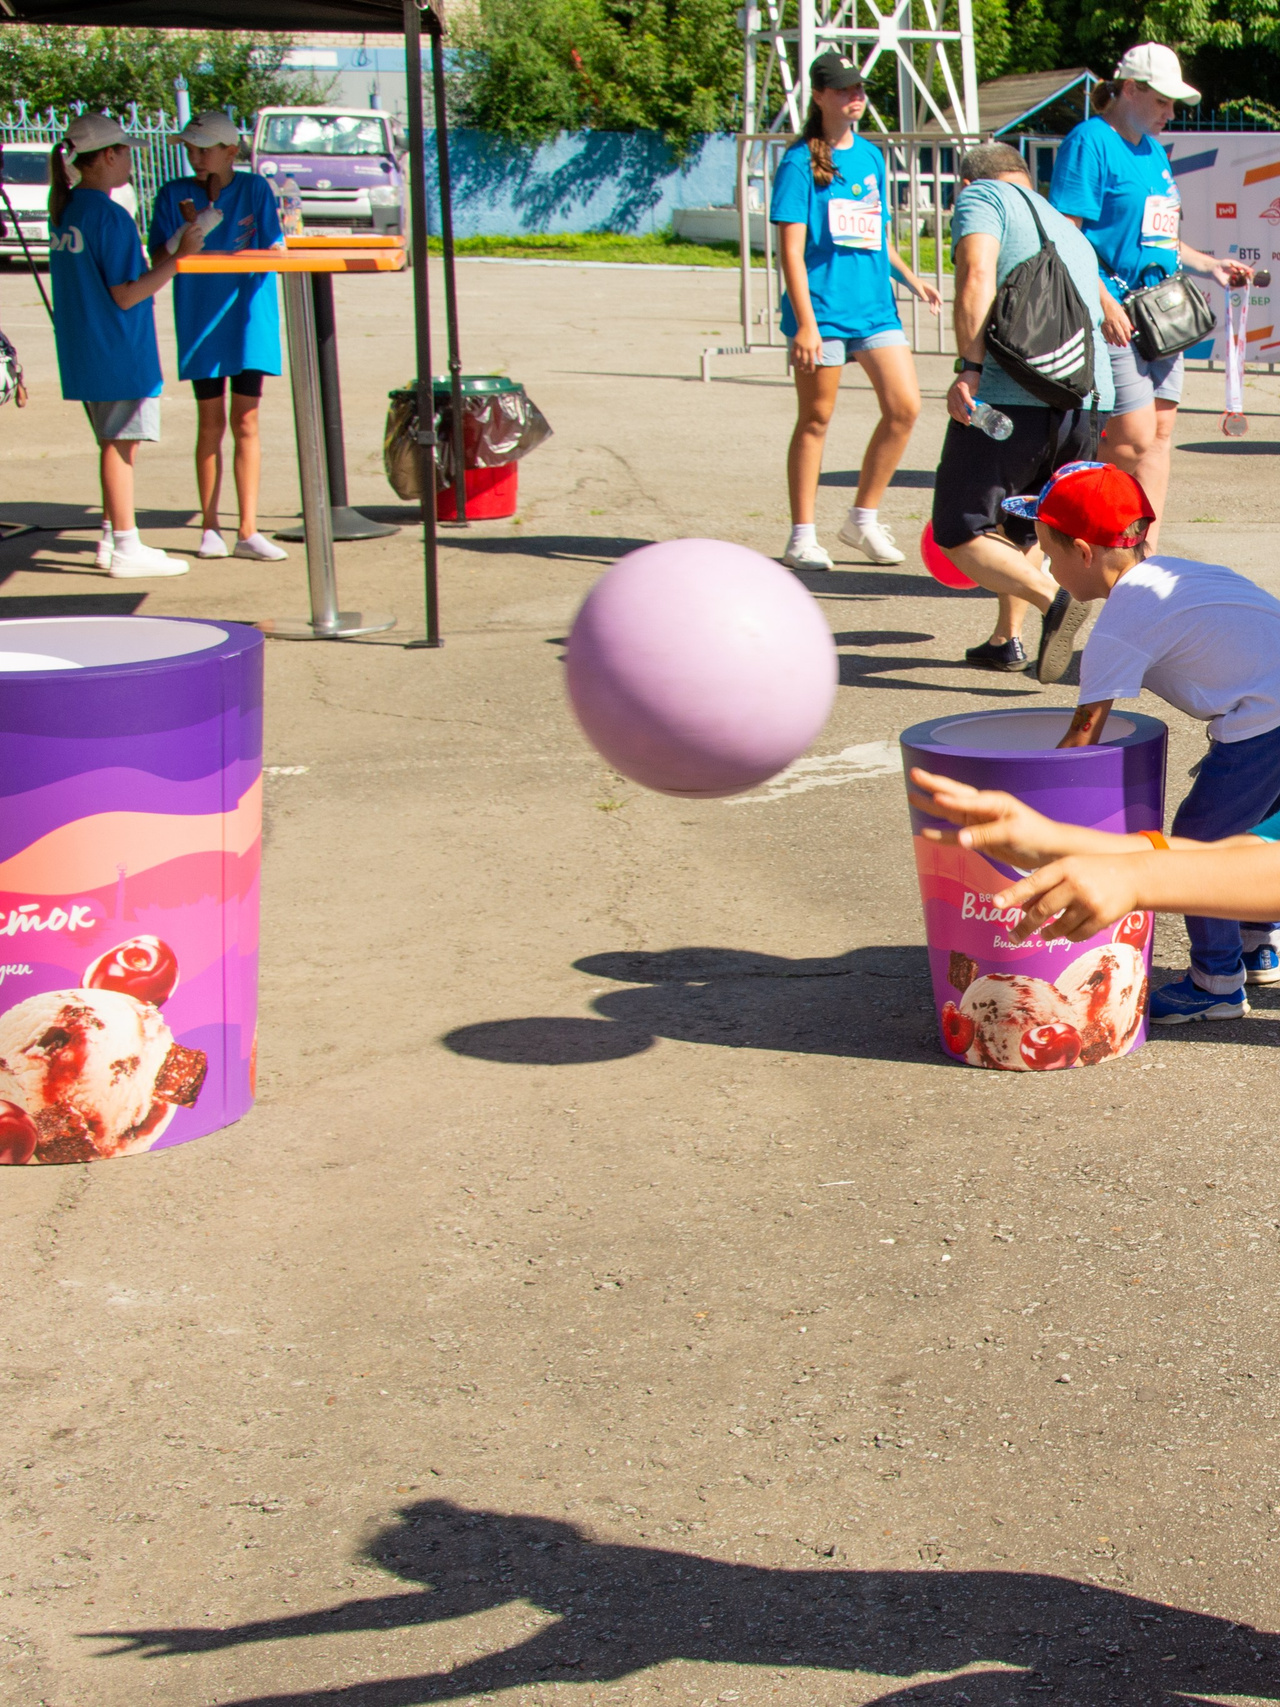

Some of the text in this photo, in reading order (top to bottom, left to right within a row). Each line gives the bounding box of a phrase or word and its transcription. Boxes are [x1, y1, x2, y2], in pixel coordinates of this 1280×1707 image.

[837, 214, 876, 234] 0104
[1152, 212, 1178, 234] 028
[1239, 248, 1261, 260] ВТБ
